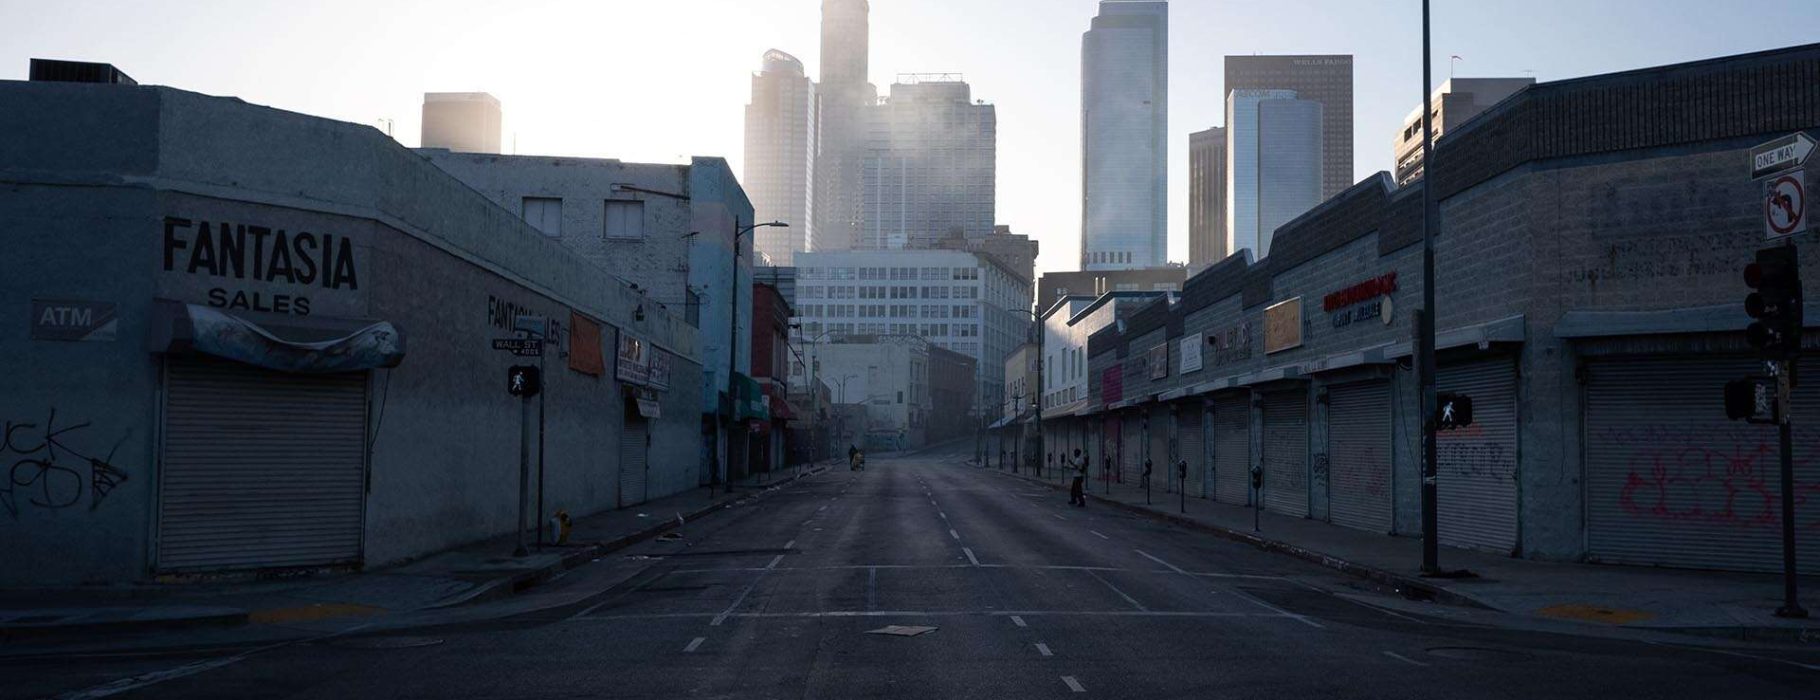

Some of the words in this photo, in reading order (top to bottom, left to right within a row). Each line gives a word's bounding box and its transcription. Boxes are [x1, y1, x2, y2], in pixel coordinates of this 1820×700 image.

[1757, 152, 1774, 168] ONE
[1778, 145, 1795, 161] WAY
[163, 217, 357, 290] FANTASIA
[208, 288, 310, 316] SALES
[488, 294, 532, 333] FANT
[40, 307, 92, 326] ATM
[496, 341, 520, 349] WALL
